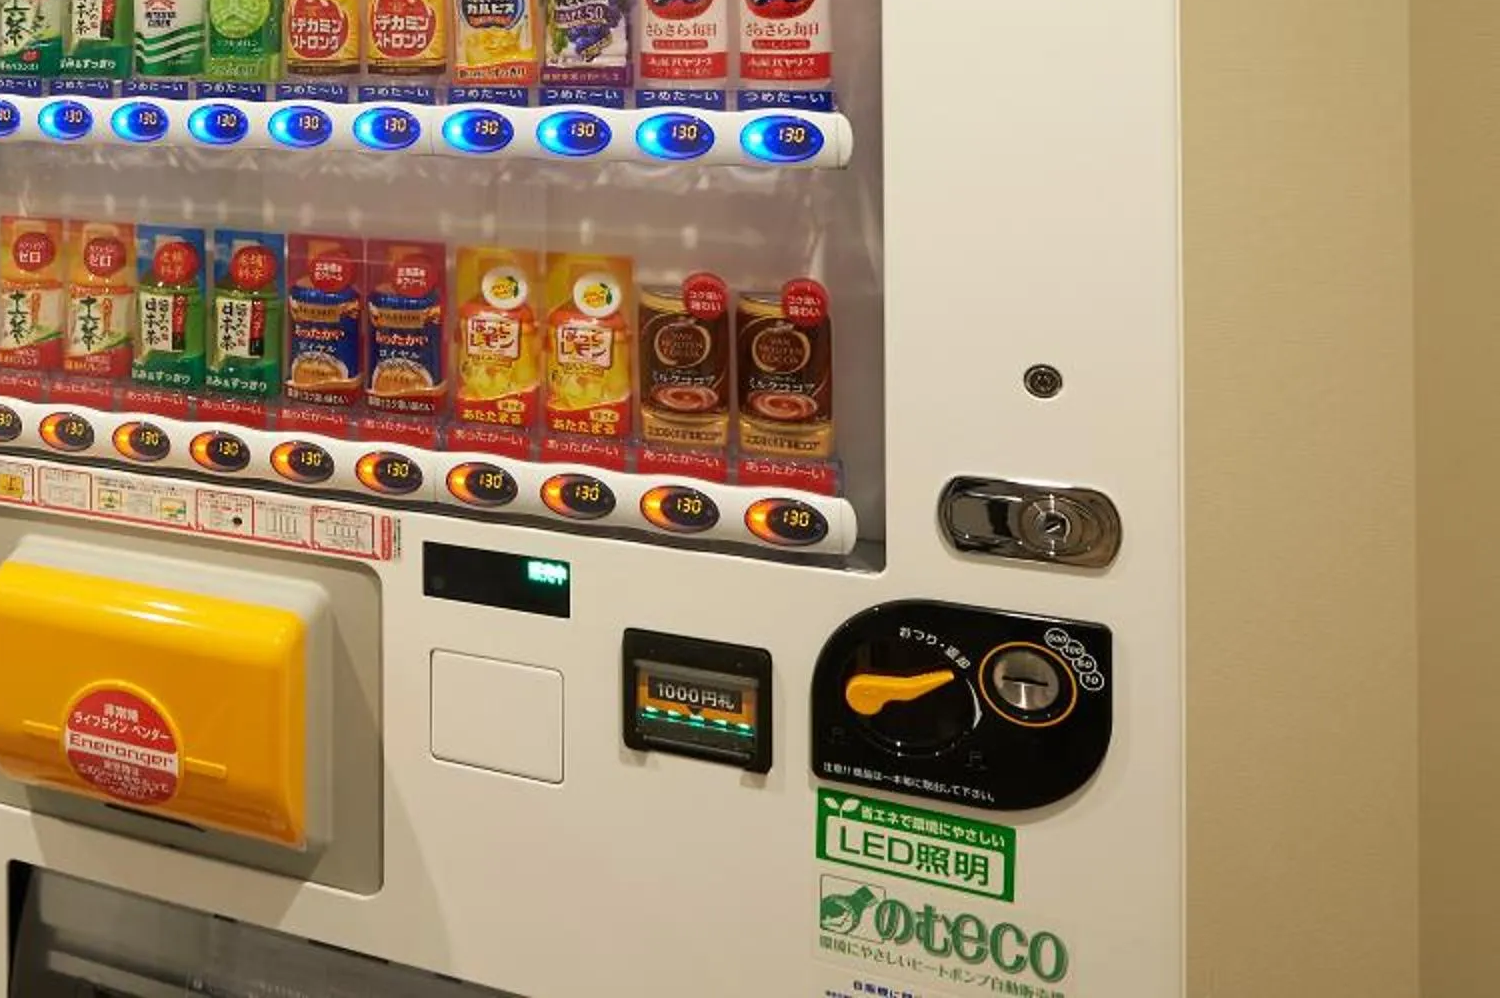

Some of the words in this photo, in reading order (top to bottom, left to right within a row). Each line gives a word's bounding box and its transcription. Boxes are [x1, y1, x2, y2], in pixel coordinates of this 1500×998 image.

[299, 116, 319, 130] 130
[385, 118, 406, 131] 130
[476, 120, 498, 134] 130
[571, 124, 594, 137] 130
[672, 125, 696, 139] 130
[779, 128, 805, 142] 130
[301, 452, 321, 465] 130
[387, 463, 408, 477] 130
[479, 474, 502, 488] 130
[575, 486, 598, 500] 130
[677, 499, 701, 514] 130
[783, 512, 809, 526] 130
[657, 682, 734, 710] 1000円札
[74, 711, 128, 733] ライフライン
[840, 826, 989, 886] LED照明
